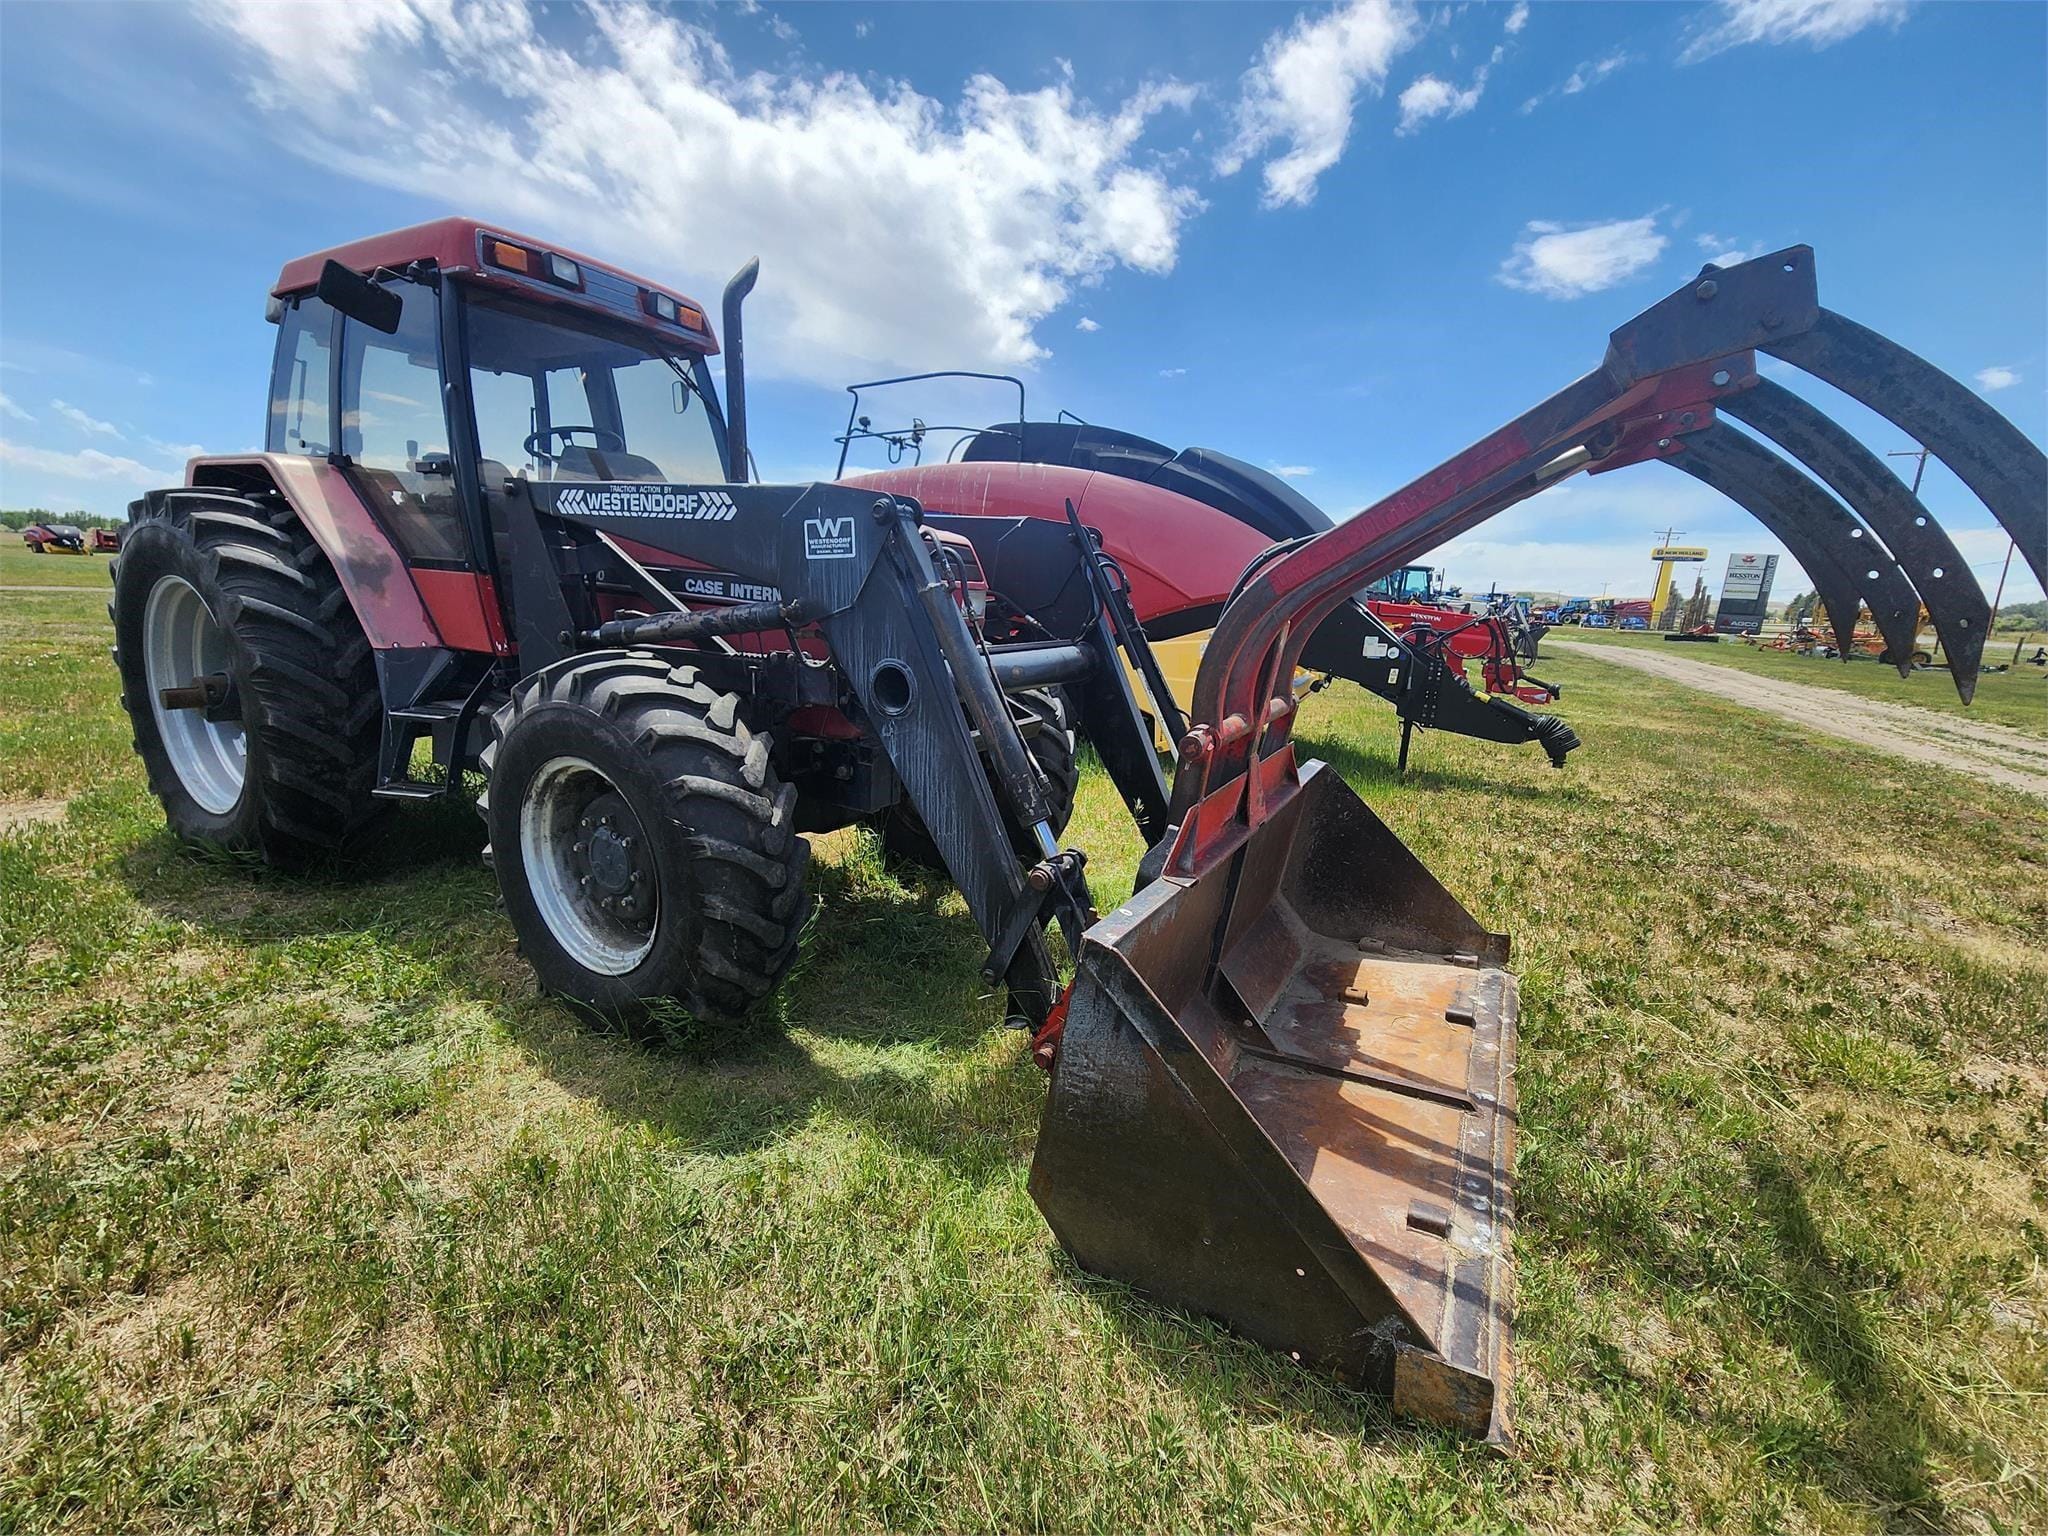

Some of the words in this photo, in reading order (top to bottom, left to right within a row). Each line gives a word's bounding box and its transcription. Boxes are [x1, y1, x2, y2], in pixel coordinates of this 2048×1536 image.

[610, 485, 636, 493] TRACTION
[639, 485, 660, 493] ACTION
[586, 493, 698, 513] WESTENDORF
[815, 517, 842, 538] W
[685, 578, 724, 595] CASE
